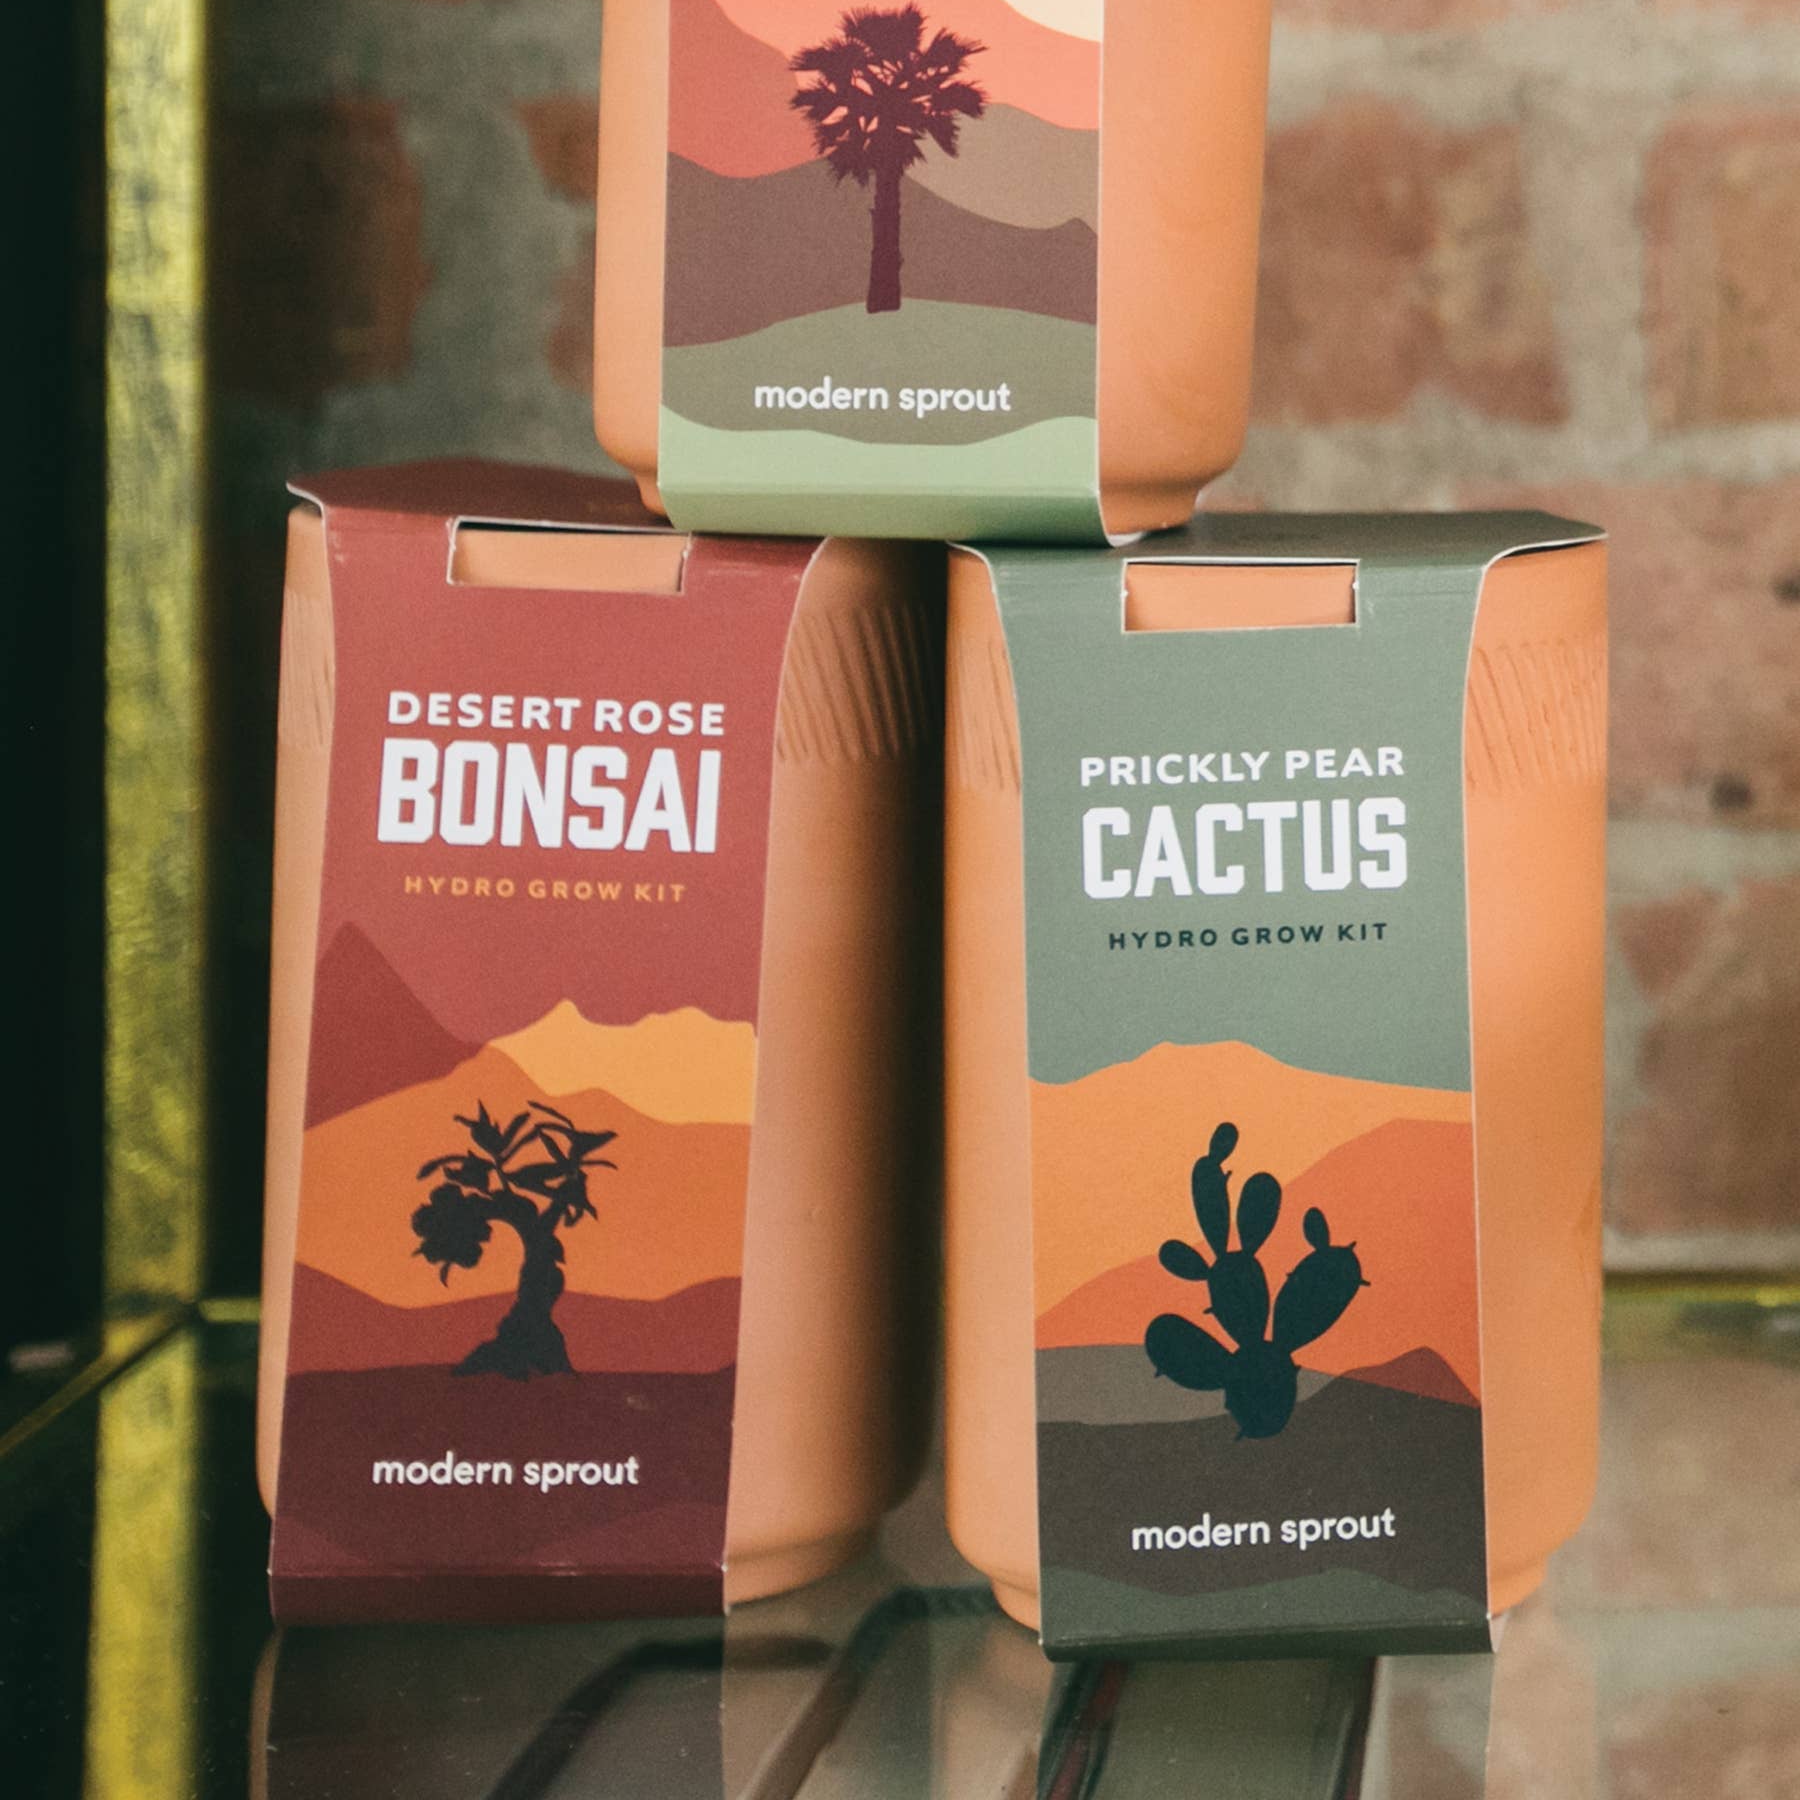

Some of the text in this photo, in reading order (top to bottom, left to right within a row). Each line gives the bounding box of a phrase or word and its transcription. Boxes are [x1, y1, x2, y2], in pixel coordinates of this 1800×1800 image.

[753, 375, 1012, 419] modern sprout
[387, 690, 725, 736] DESERT ROSE
[1080, 746, 1405, 787] PRICKLY PEAR
[377, 736, 722, 854] BONSAI
[1082, 796, 1408, 899] CACTUS
[404, 875, 687, 902] HYDRO GROW KIT
[1108, 922, 1388, 950] HYDRO GROW KIT
[371, 1450, 640, 1494] modern sprout
[1131, 1506, 1396, 1551] modern sprout
